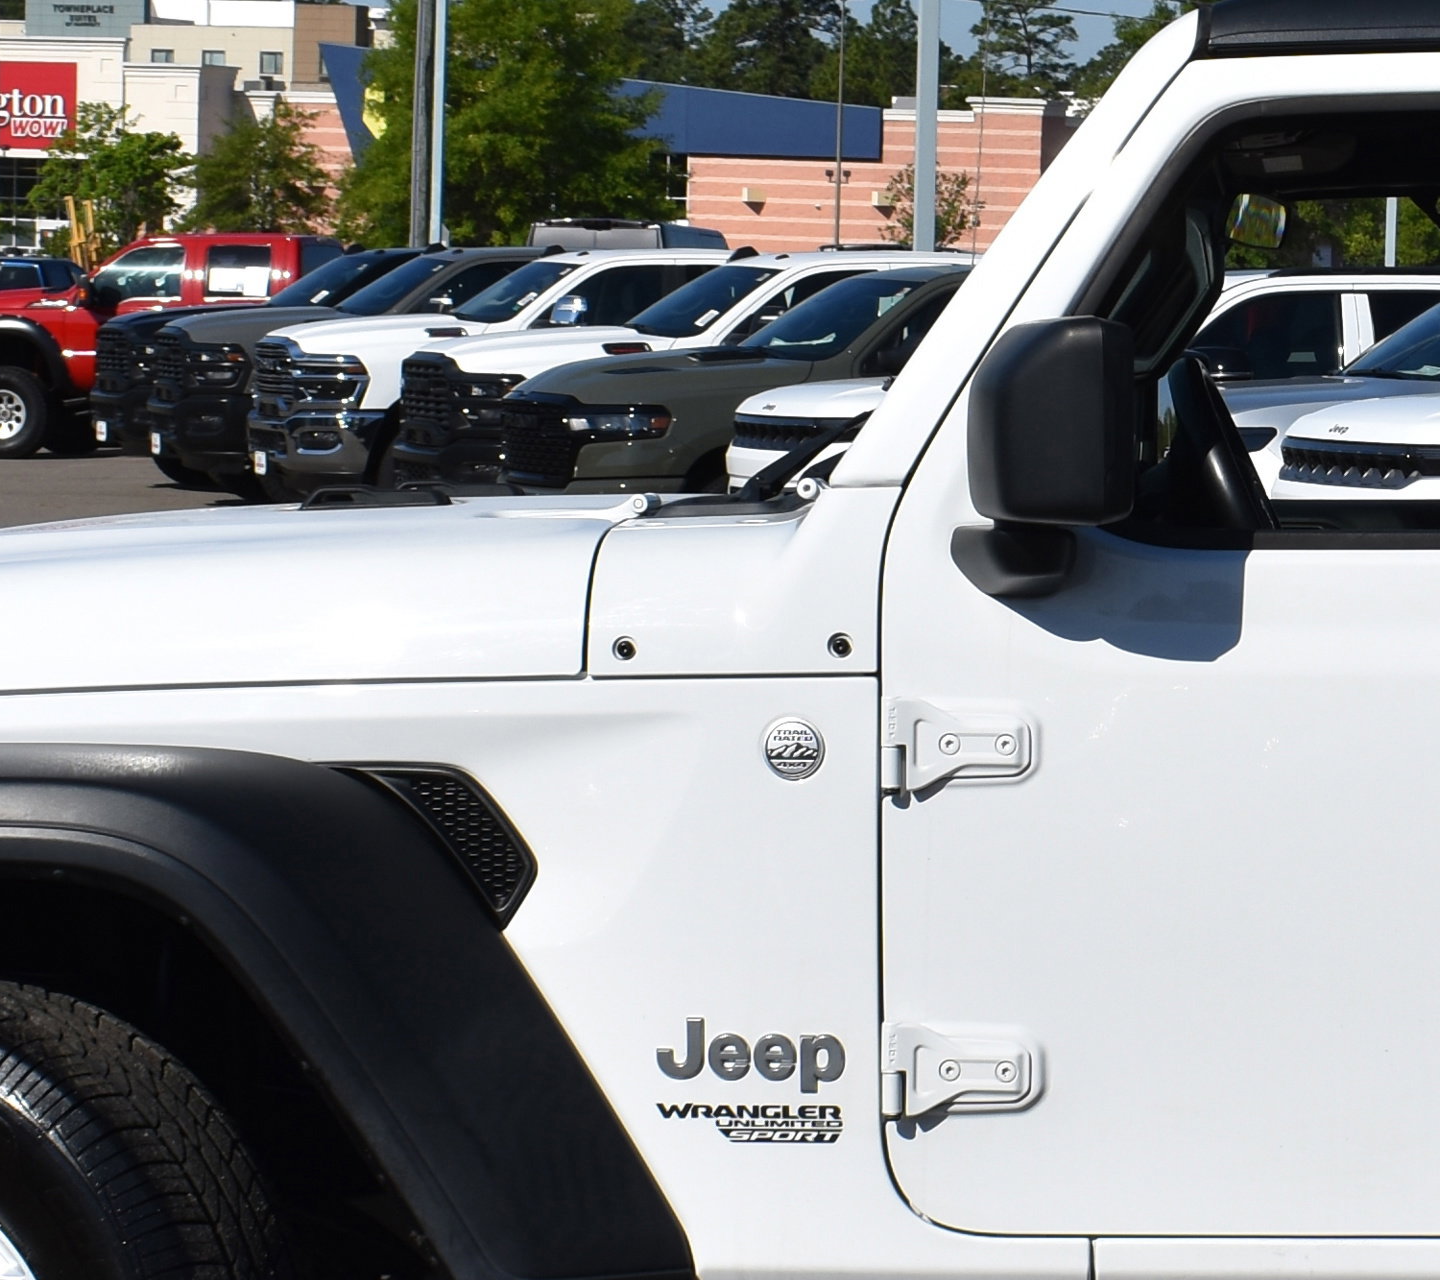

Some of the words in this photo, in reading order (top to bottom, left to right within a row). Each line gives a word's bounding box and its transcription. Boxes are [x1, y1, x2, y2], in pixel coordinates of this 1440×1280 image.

[53, 4, 115, 14] TOWNEPLACE
[656, 1017, 846, 1095] Jeep
[656, 1103, 842, 1120] WRANGLER
[715, 1120, 844, 1128] UNLIMITED
[728, 1130, 841, 1142] SPORT
